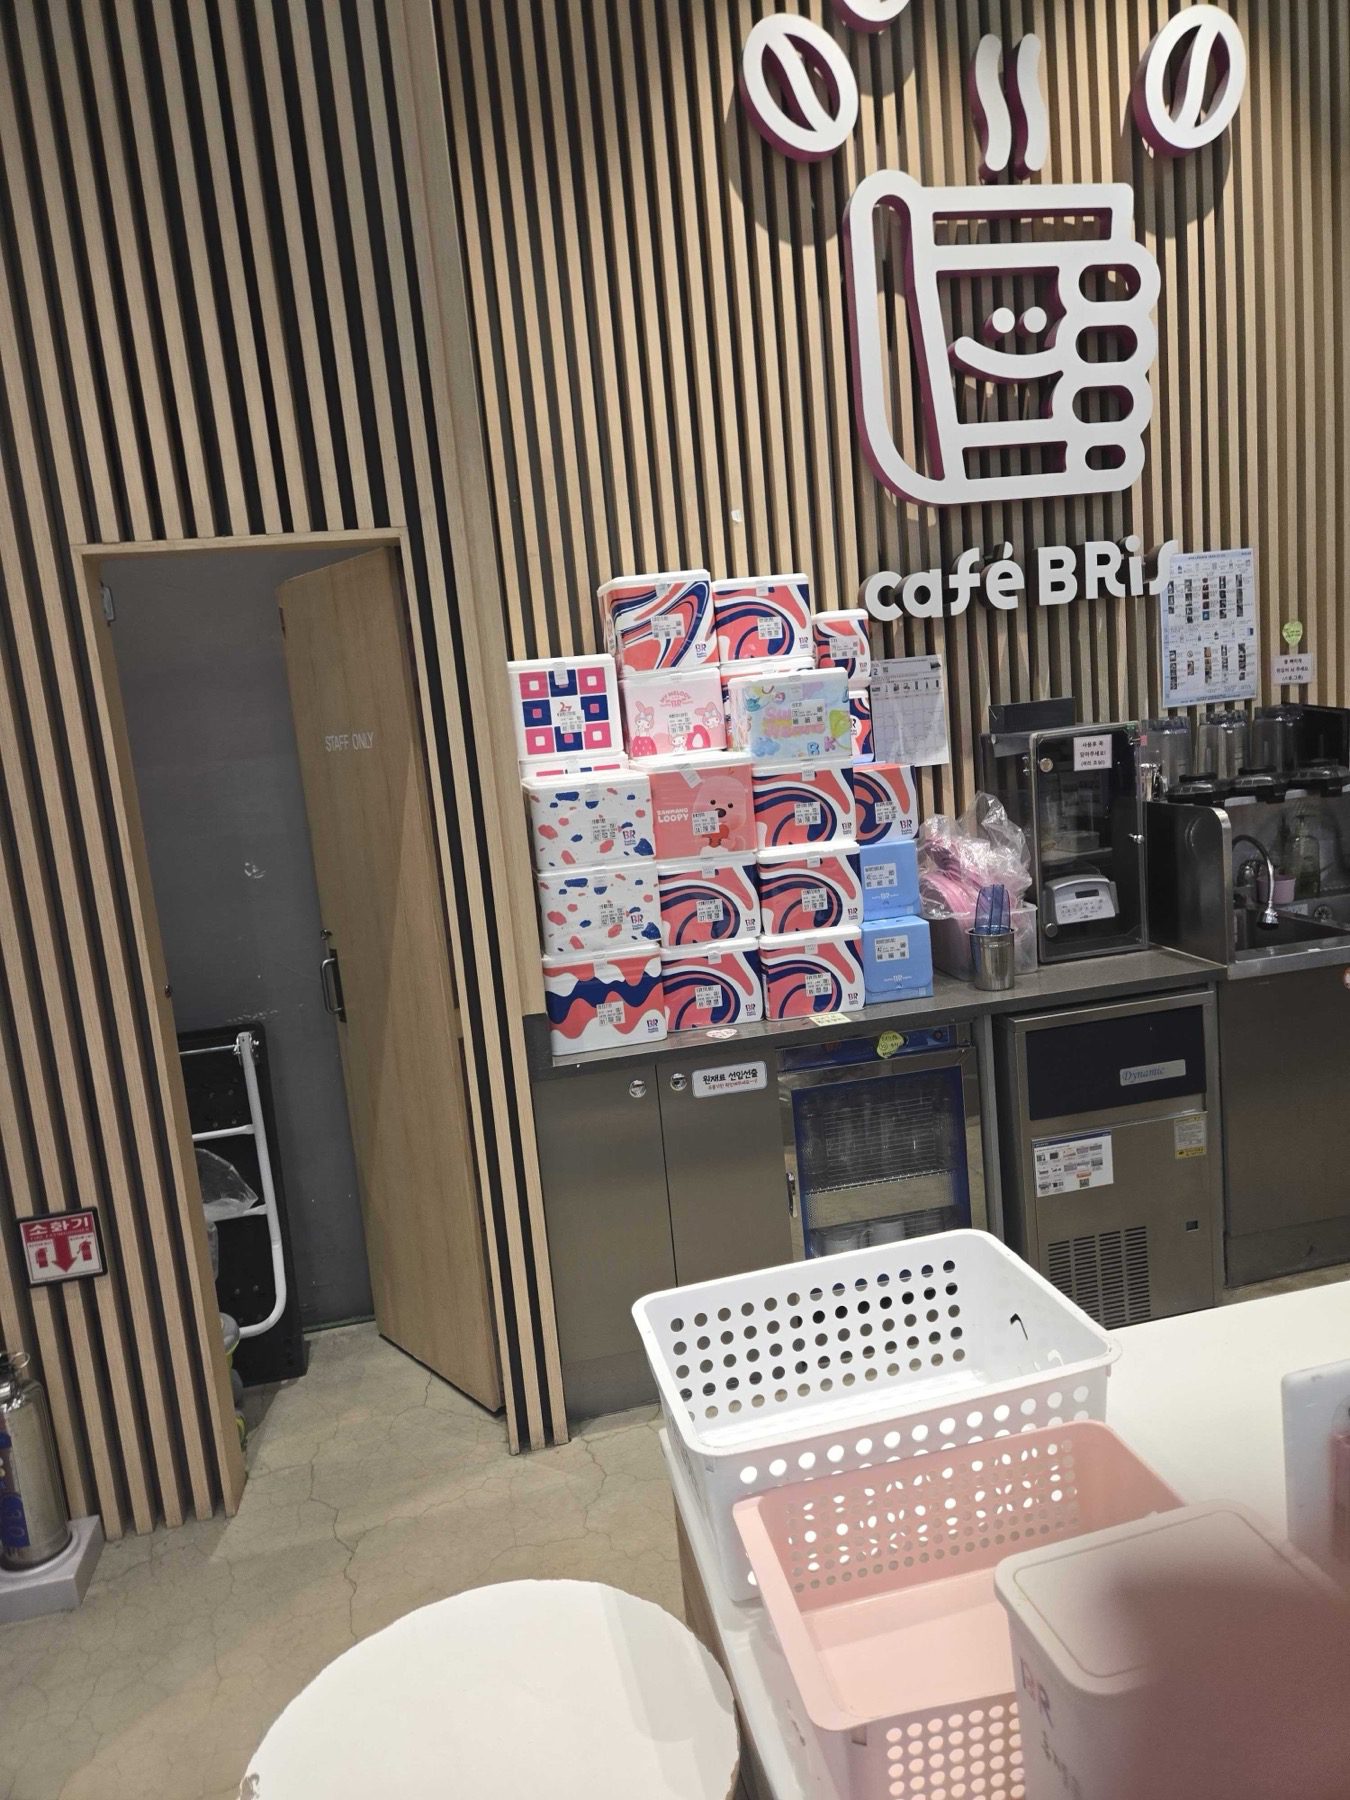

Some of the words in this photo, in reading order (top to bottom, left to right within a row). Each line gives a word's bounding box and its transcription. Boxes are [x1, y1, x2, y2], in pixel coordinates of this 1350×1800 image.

[865, 541, 1024, 621] café
[695, 643, 706, 652] BR
[325, 734, 349, 752] STAFF
[352, 732, 374, 750] ONLY
[657, 813, 689, 823] LOOPY
[900, 820, 912, 829] BR
[703, 1073, 726, 1085] 원재료
[728, 1068, 758, 1081] 선입선출
[1122, 1066, 1166, 1083] Dynamic
[29, 1216, 89, 1236] 소화기
